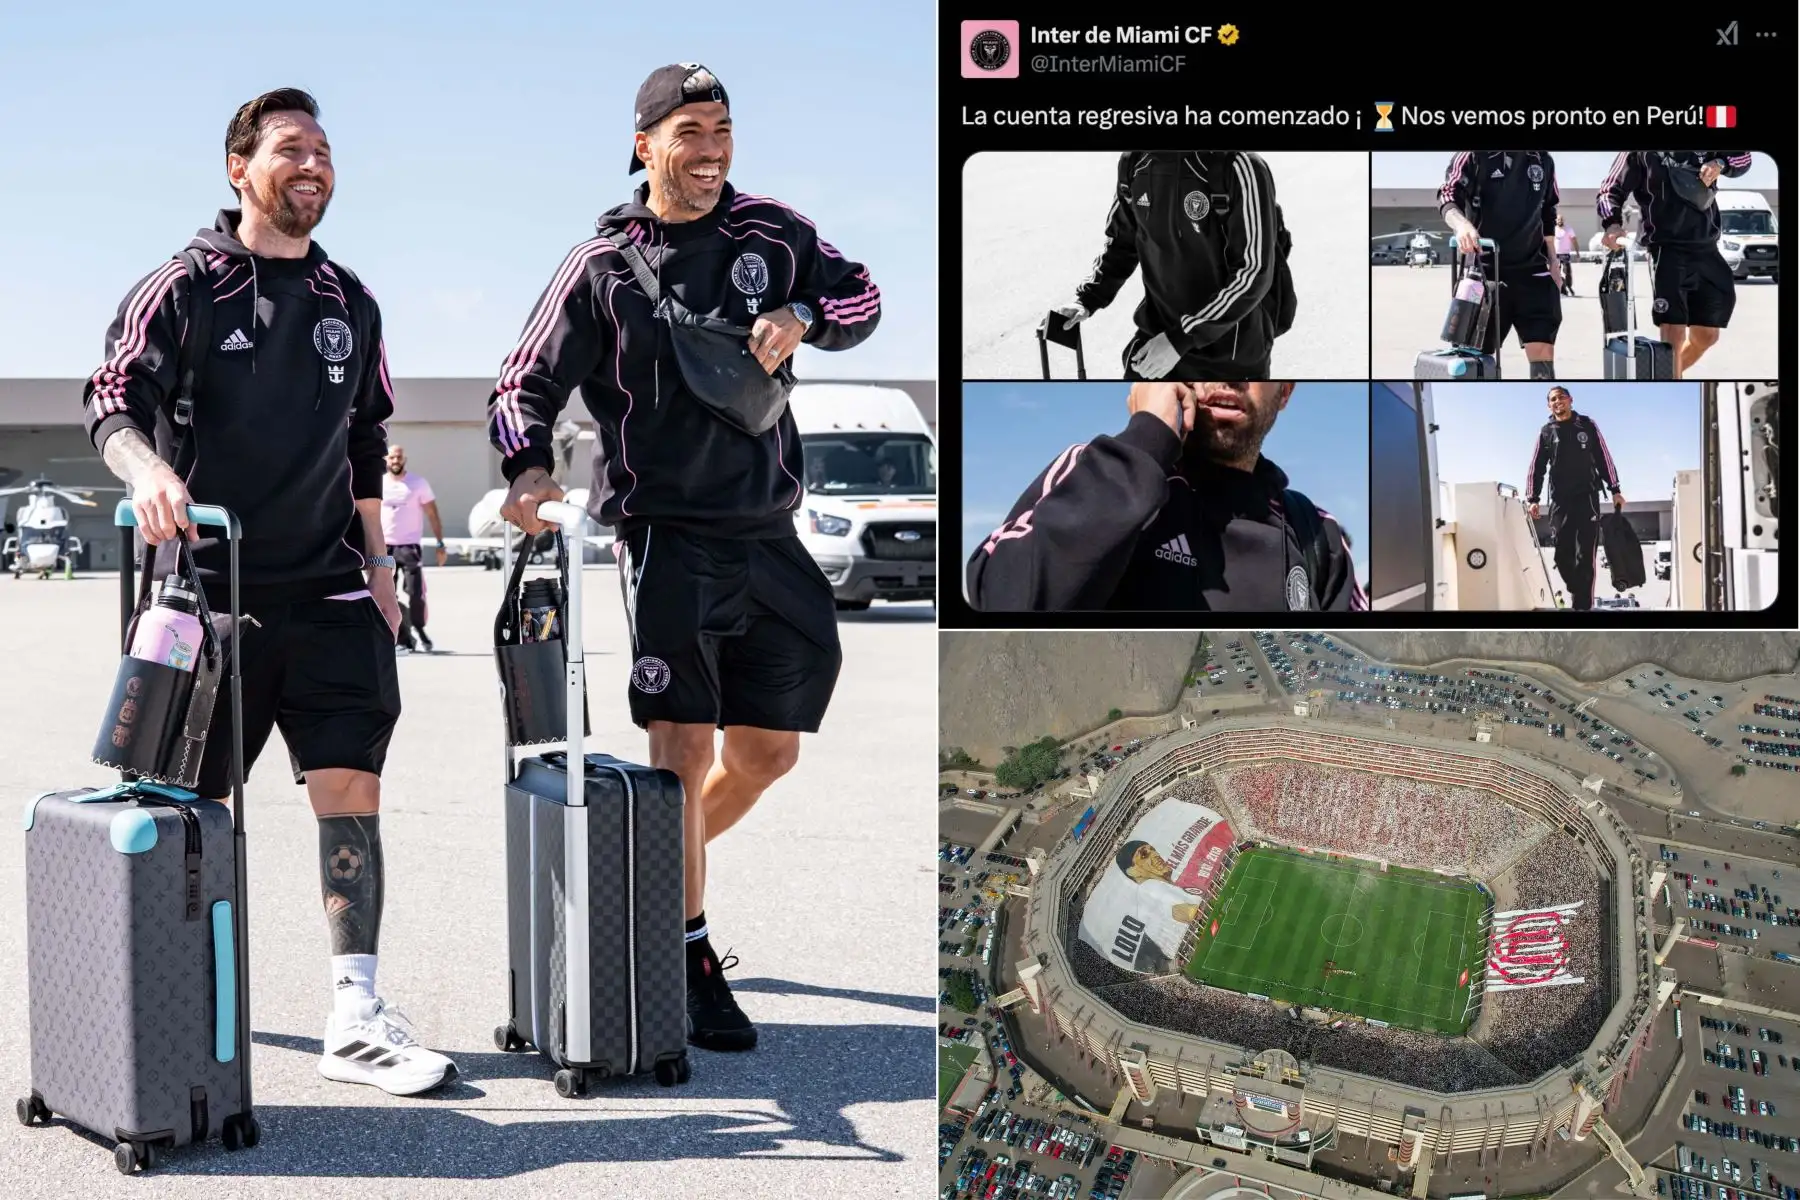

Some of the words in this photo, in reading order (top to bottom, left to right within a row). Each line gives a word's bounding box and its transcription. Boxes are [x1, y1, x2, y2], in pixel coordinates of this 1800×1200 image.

[1031, 26, 1081, 44] Inter
[1084, 25, 1112, 44] de
[1116, 25, 1180, 44] Miami
[1184, 26, 1213, 44] CF
[1031, 54, 1187, 73] @InterMiamiCF
[962, 105, 987, 126] La
[993, 106, 1071, 126] cuenta
[1078, 105, 1178, 130] regresiva
[1185, 104, 1212, 126] ha
[1218, 104, 1350, 126] comenzado
[1402, 105, 1446, 126] Nos
[1451, 110, 1526, 126] vemos
[1532, 106, 1607, 130] pronto
[1612, 110, 1640, 126] en
[1647, 104, 1704, 126] Perú!
[220, 341, 254, 351] adidas
[1154, 548, 1198, 567] adidas
[1181, 816, 1213, 844] GRANDE
[1111, 914, 1146, 963] LOLO
